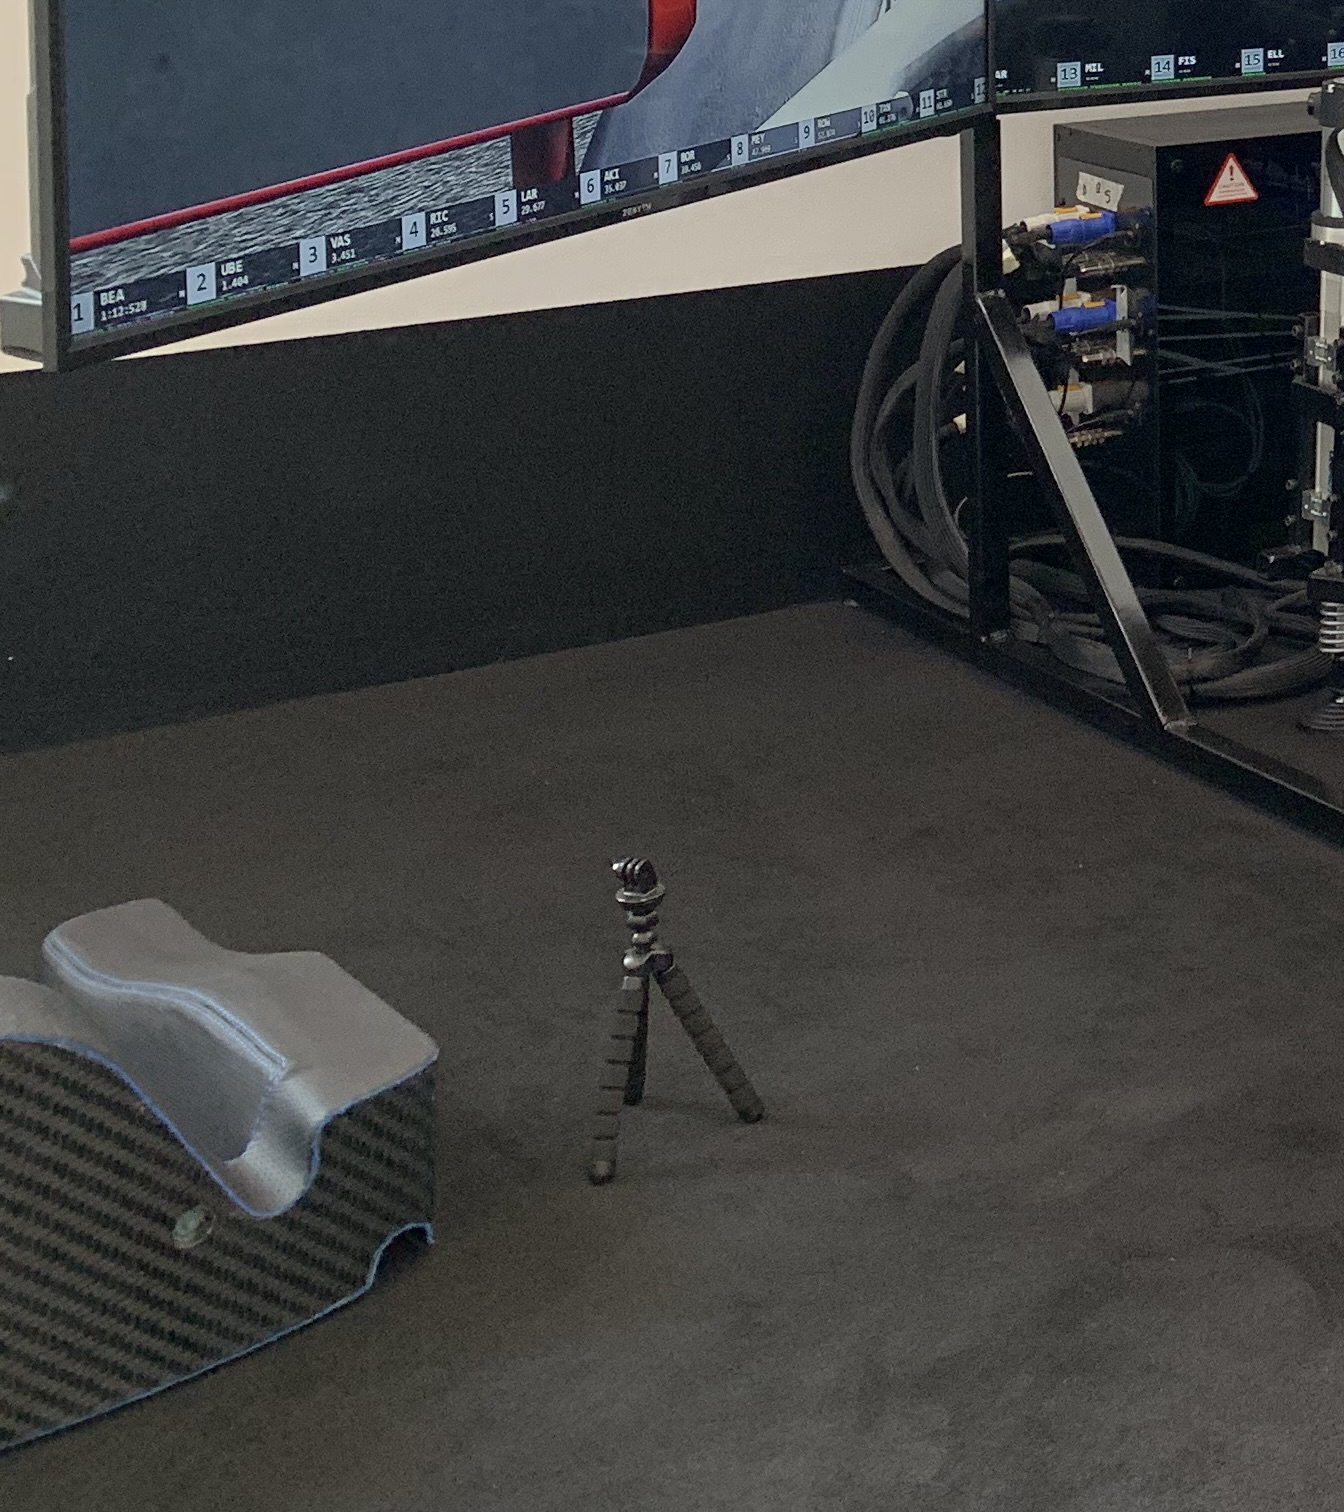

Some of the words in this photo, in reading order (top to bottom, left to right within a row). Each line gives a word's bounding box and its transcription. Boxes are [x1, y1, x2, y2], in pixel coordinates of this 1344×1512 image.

[1177, 55, 1197, 66] FIS
[1244, 53, 1261, 66] 15
[1267, 49, 1285, 59] ELL
[1060, 67, 1078, 81] 13
[1084, 63, 1105, 73] MIL
[1154, 60, 1171, 73] 14
[921, 95, 933, 109] 11
[863, 109, 875, 125] 10
[803, 124, 811, 140] 9
[736, 141, 743, 156] 8
[664, 158, 672, 174] 7
[587, 178, 595, 194] 6
[520, 188, 538, 203] LAR
[502, 198, 510, 215] 5
[429, 209, 449, 225] RIC
[408, 220, 419, 237] 4
[330, 233, 352, 249] VAS
[308, 245, 318, 263] 3
[221, 259, 244, 276] UBE
[196, 272, 207, 292] 2
[100, 288, 125, 306] BEA
[72, 302, 84, 322] 1
